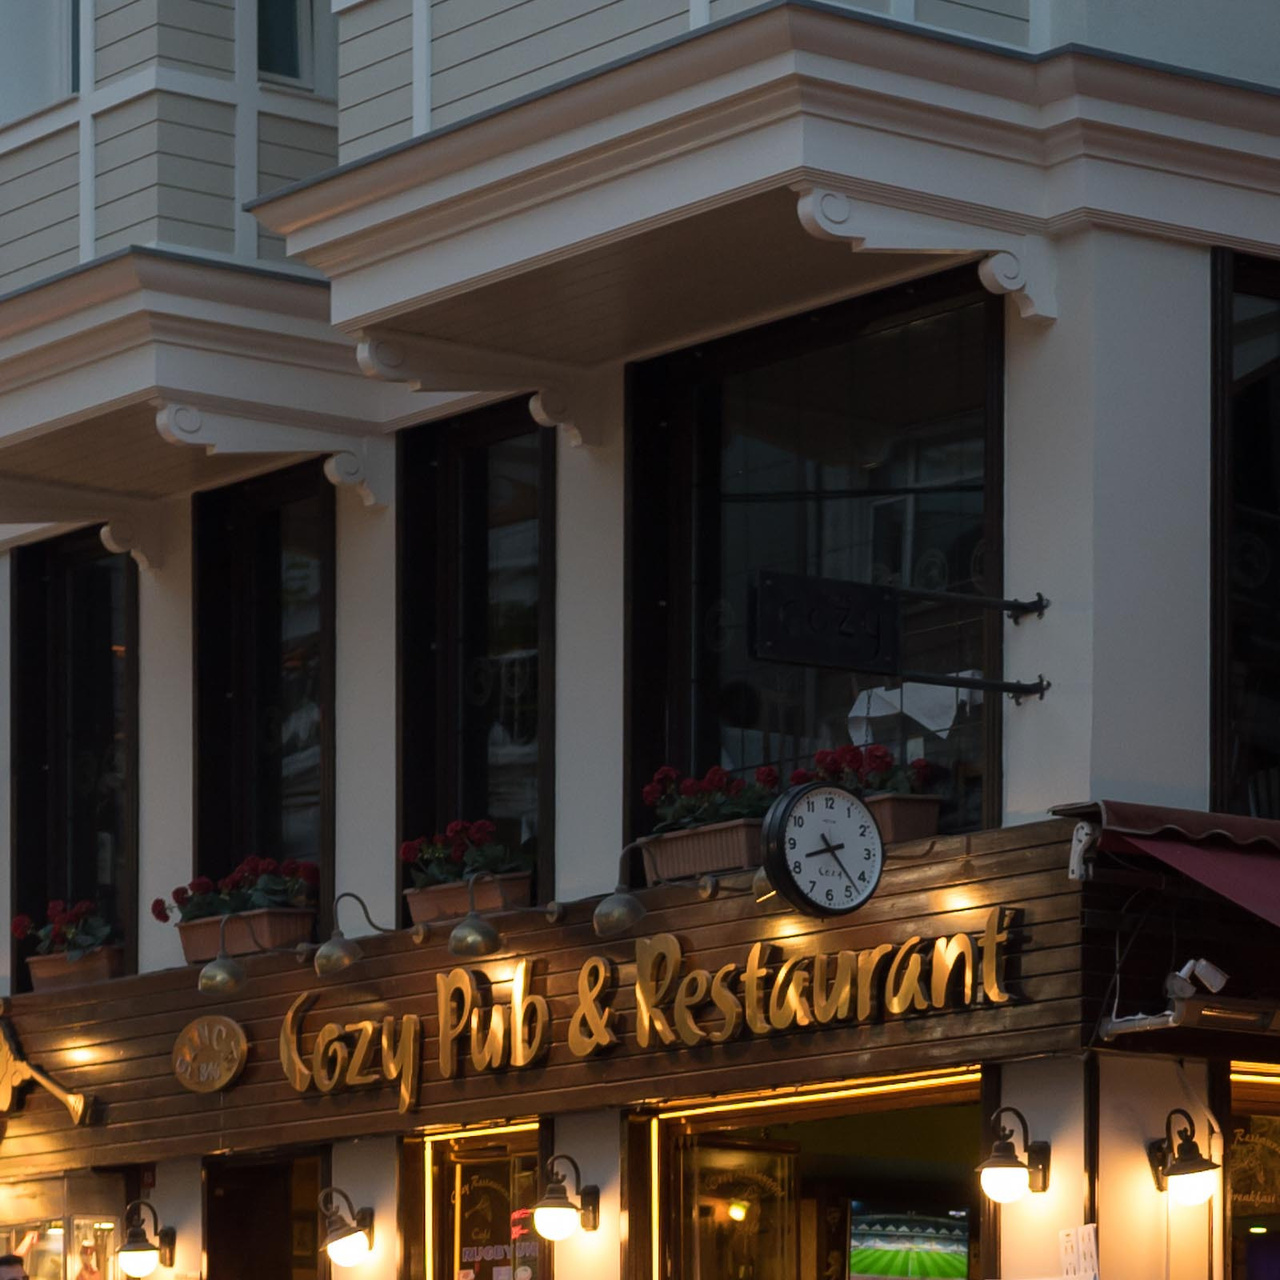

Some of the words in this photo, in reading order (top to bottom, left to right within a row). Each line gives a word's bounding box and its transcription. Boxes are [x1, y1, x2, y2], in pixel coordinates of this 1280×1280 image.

[807, 801, 815, 813] 11
[825, 797, 835, 810] 12
[846, 806, 852, 818] 1
[794, 816, 804, 828] 10
[858, 825, 867, 837] 2
[788, 838, 797, 850] 9
[863, 848, 871, 860] 3
[793, 861, 802, 874] 8
[858, 870, 867, 883] 4
[809, 880, 817, 893] 7
[845, 885, 853, 898] 5
[826, 889, 835, 901] 6
[280, 992, 420, 1114] Cozy
[437, 957, 552, 1078] Pub
[568, 957, 618, 1056] &
[637, 907, 1009, 1048] Restaurant
[1230, 1189, 1276, 1208] reakfast
[462, 1244, 512, 1262] RUGBY
